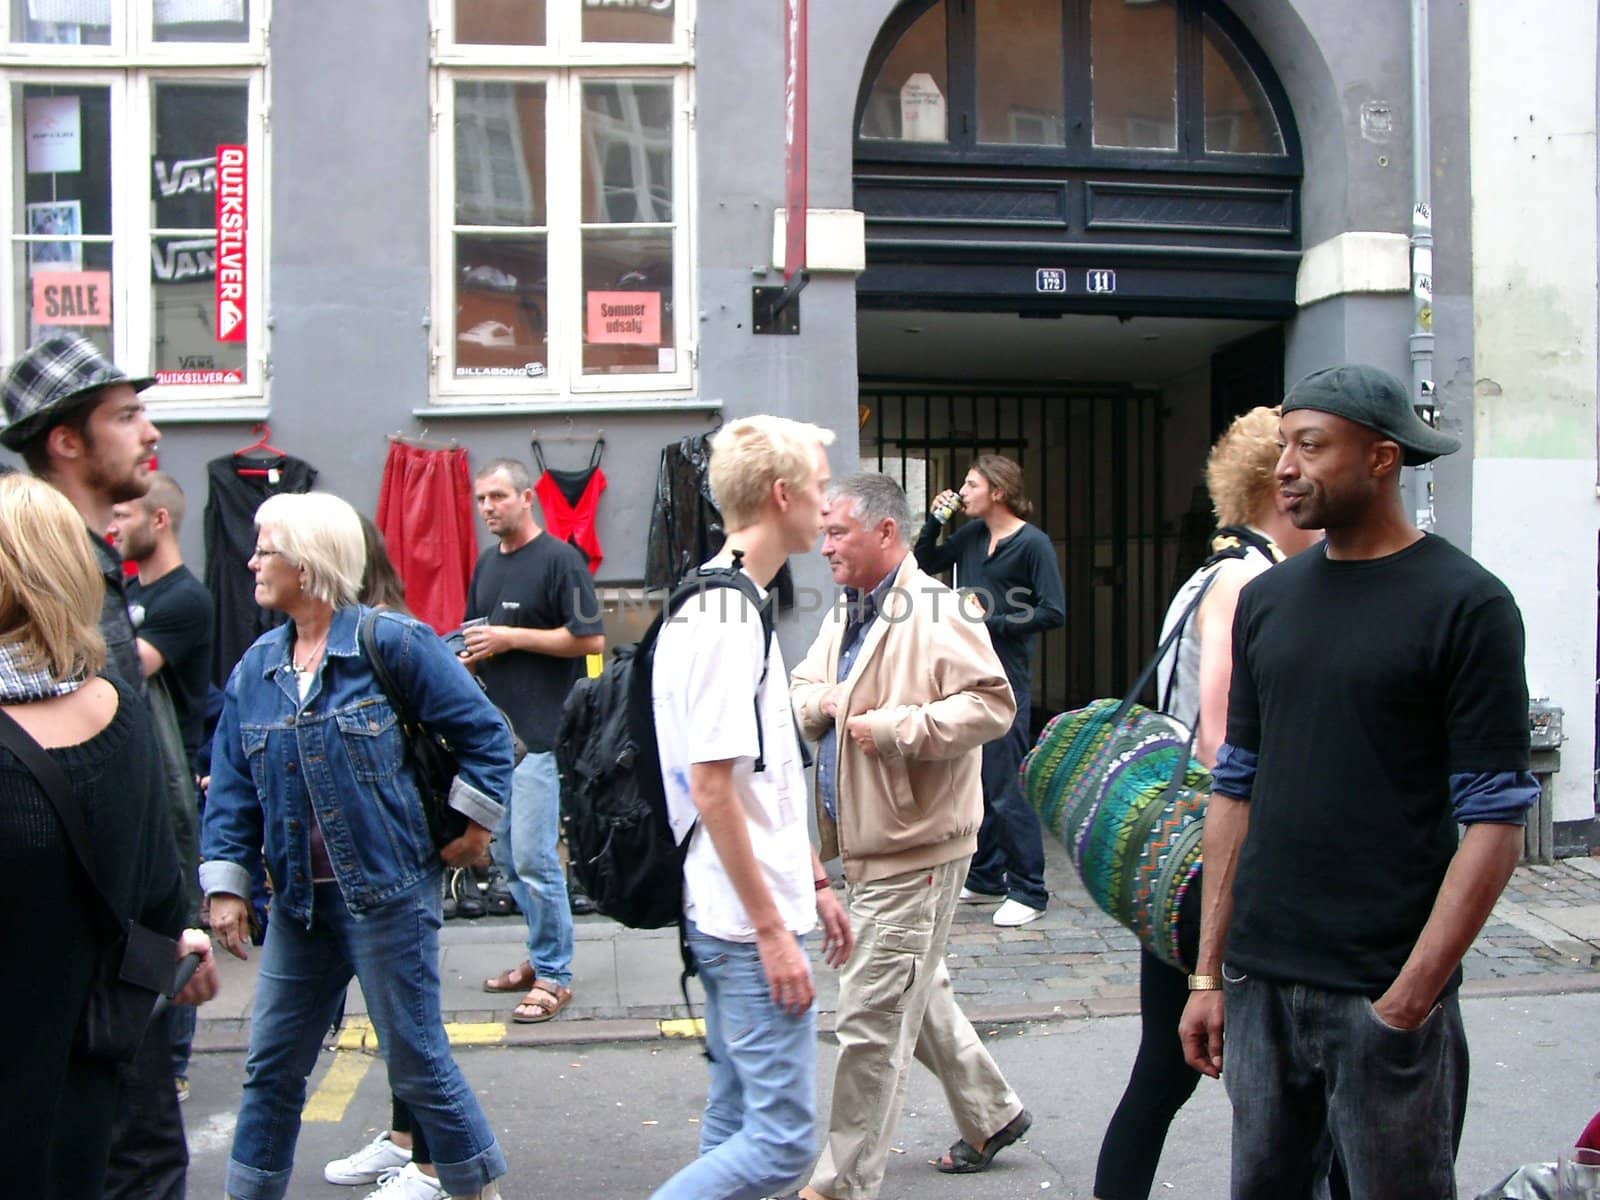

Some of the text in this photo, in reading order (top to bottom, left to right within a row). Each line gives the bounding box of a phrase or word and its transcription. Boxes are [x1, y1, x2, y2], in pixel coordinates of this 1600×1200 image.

[154, 157, 217, 196] VAN
[219, 149, 244, 299] QUIKSILVER
[151, 238, 217, 279] VAN
[1043, 278, 1060, 290] 172
[1094, 271, 1109, 290] 11
[44, 284, 100, 318] SALE
[601, 303, 646, 317] Sommer
[178, 355, 216, 370] VANS
[156, 372, 223, 384] QUIKSILVER
[456, 367, 528, 377] BILLABONG
